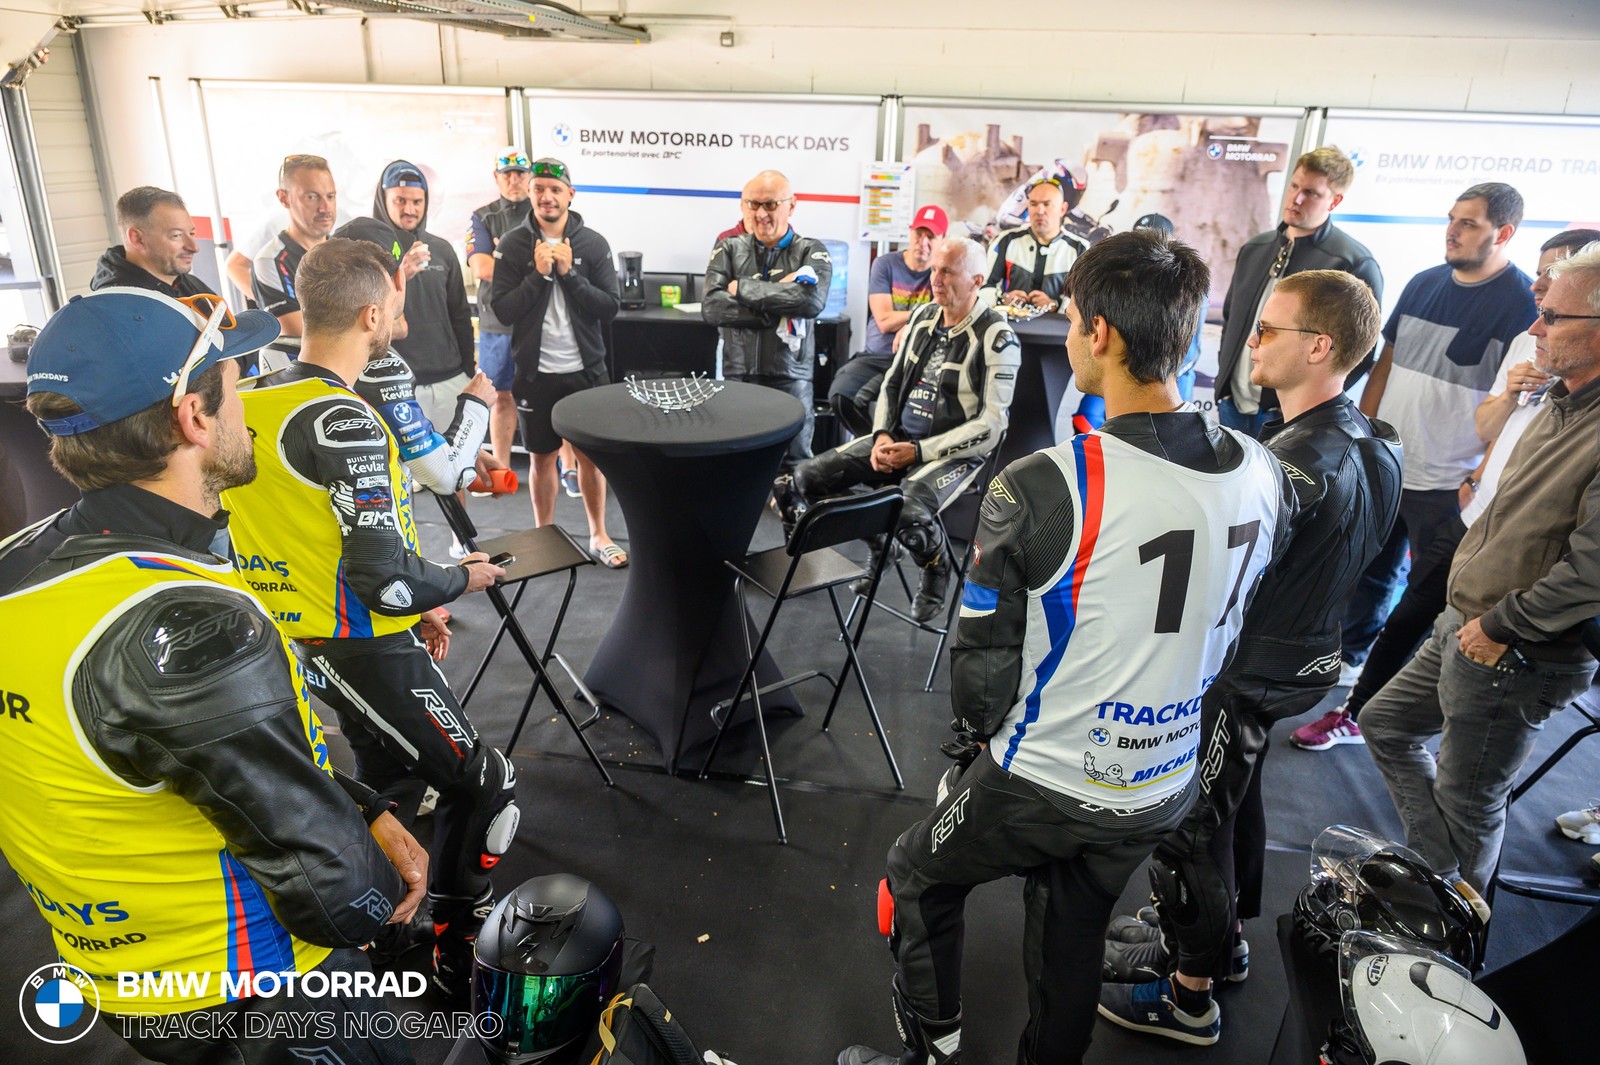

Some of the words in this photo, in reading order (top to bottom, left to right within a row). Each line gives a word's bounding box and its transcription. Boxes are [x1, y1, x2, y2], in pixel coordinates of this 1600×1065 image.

[579, 129, 625, 144] BMW
[630, 131, 733, 148] MOTORRAD
[740, 134, 799, 150] TRACK
[803, 136, 850, 152] DAYS
[593, 149, 640, 158] partenariat
[1377, 153, 1430, 170] BMW
[1435, 155, 1553, 174] MOTORRAD
[1560, 159, 1600, 175] TRA
[363, 357, 402, 374] RST
[381, 389, 413, 401] Kevlar
[325, 417, 377, 436] RST
[346, 455, 367, 464] BUILT
[368, 453, 385, 461] WITH
[348, 462, 386, 475] Kevlar
[236, 553, 290, 578] DAYS
[1138, 519, 1261, 635] 17
[156, 607, 247, 667] RST
[410, 688, 474, 749] RST
[1117, 736, 1163, 750] BMW
[1200, 709, 1232, 795] RST
[1130, 744, 1201, 783] MICHE
[931, 787, 971, 854] RST
